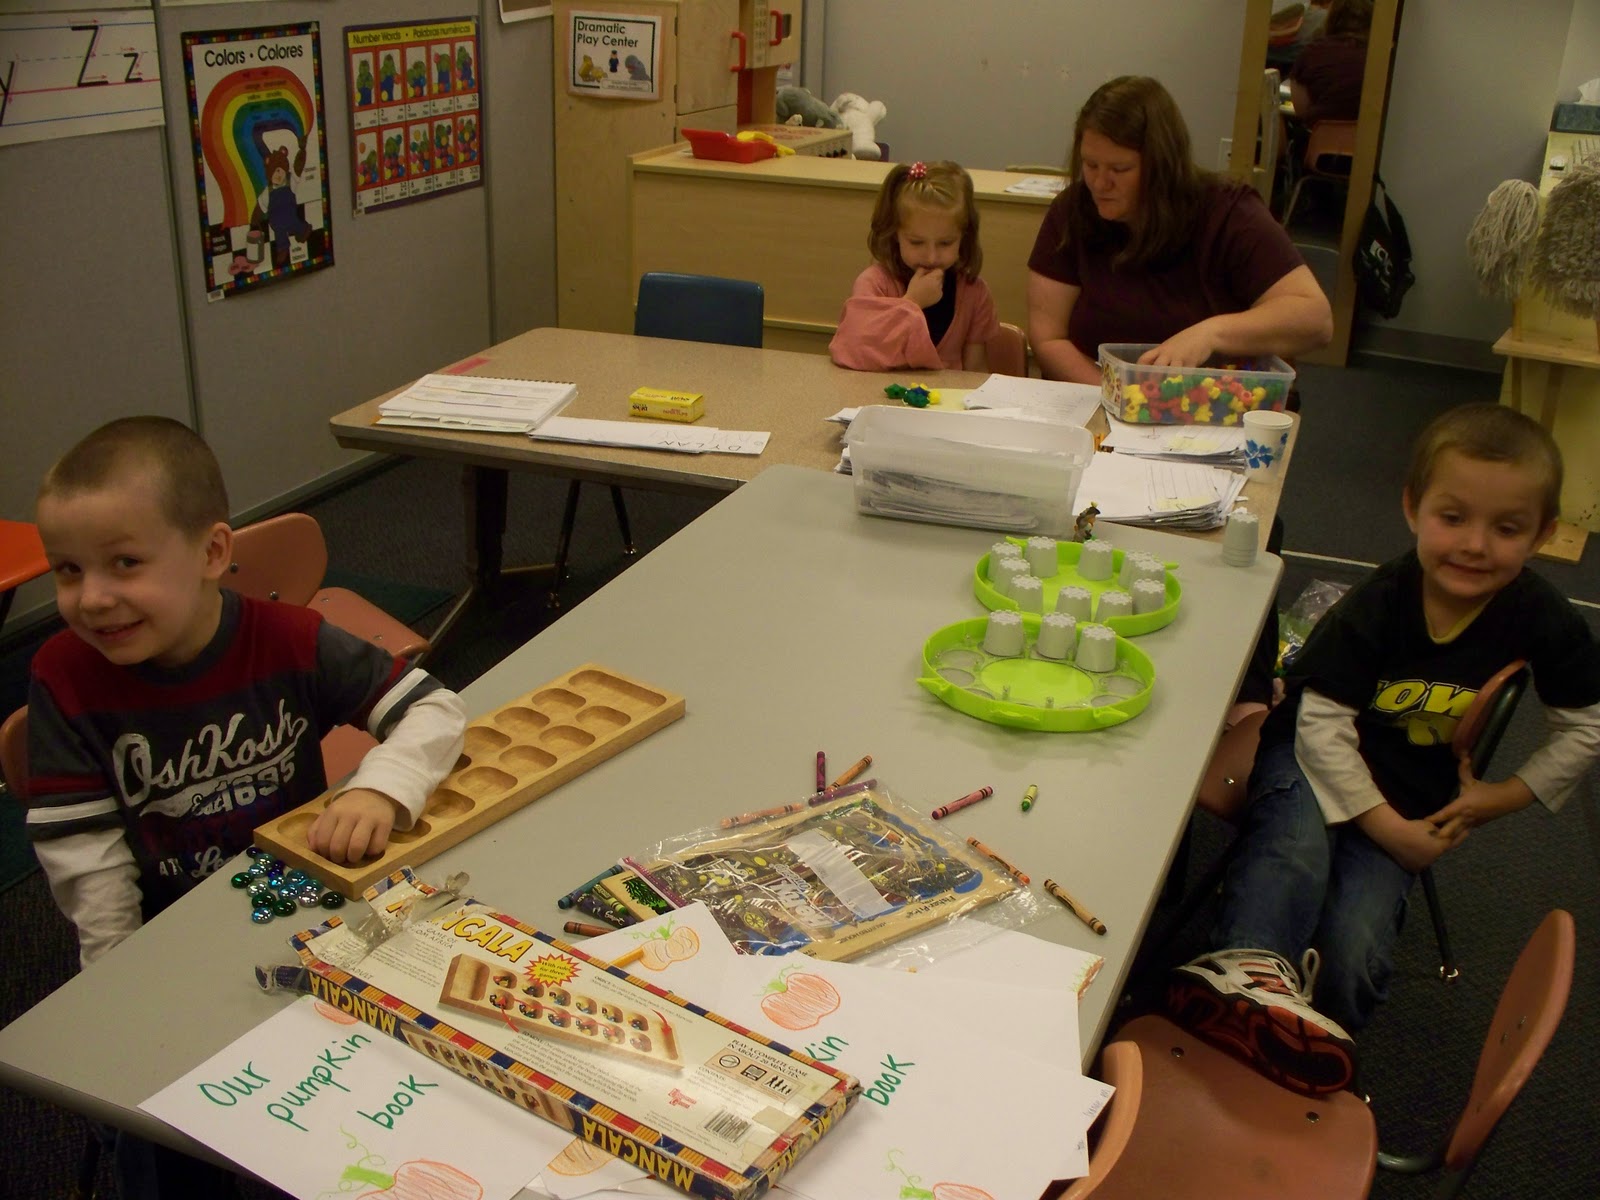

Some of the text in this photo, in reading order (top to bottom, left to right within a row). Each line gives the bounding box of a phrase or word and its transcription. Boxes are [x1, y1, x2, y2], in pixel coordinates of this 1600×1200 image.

[352, 32, 381, 44] Number
[381, 31, 402, 41] Words
[412, 27, 440, 38] Palabras
[577, 20, 626, 34] Dramatic
[577, 33, 640, 48] Play Center
[71, 25, 109, 87] Z
[123, 52, 143, 83] z
[204, 43, 304, 67] Colors Colores
[112, 699, 309, 808] OshKosh
[308, 971, 398, 1037] MANCALA
[197, 1060, 271, 1107] Our
[266, 1033, 372, 1132] pumpkin
[357, 1074, 439, 1130] book
[862, 1053, 916, 1106] book
[582, 1115, 696, 1192] MANCALA
